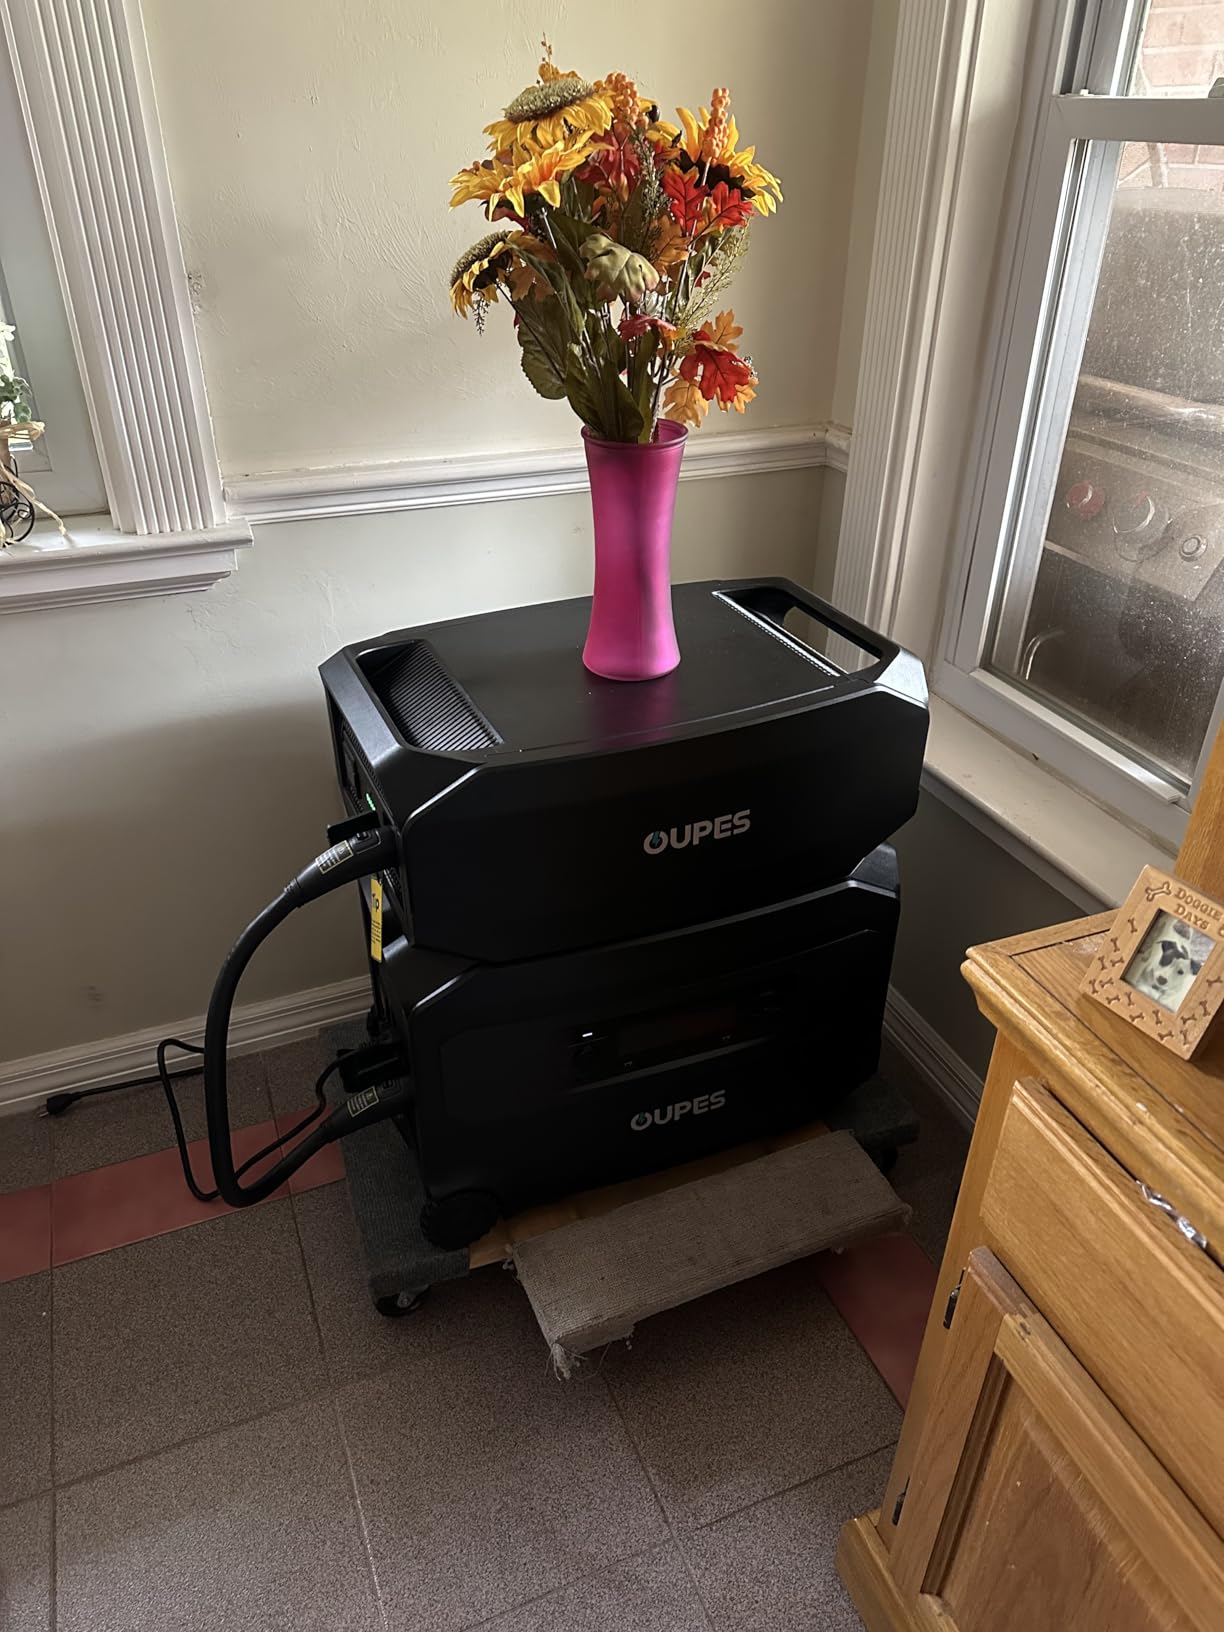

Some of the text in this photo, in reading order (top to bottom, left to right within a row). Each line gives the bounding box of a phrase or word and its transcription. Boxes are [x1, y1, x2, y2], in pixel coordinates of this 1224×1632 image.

[643, 809, 751, 855] OUPES
[1174, 887, 1222, 921] DOGGIE
[1174, 903, 1210, 930] DAYS
[630, 1089, 726, 1131] OUPES
